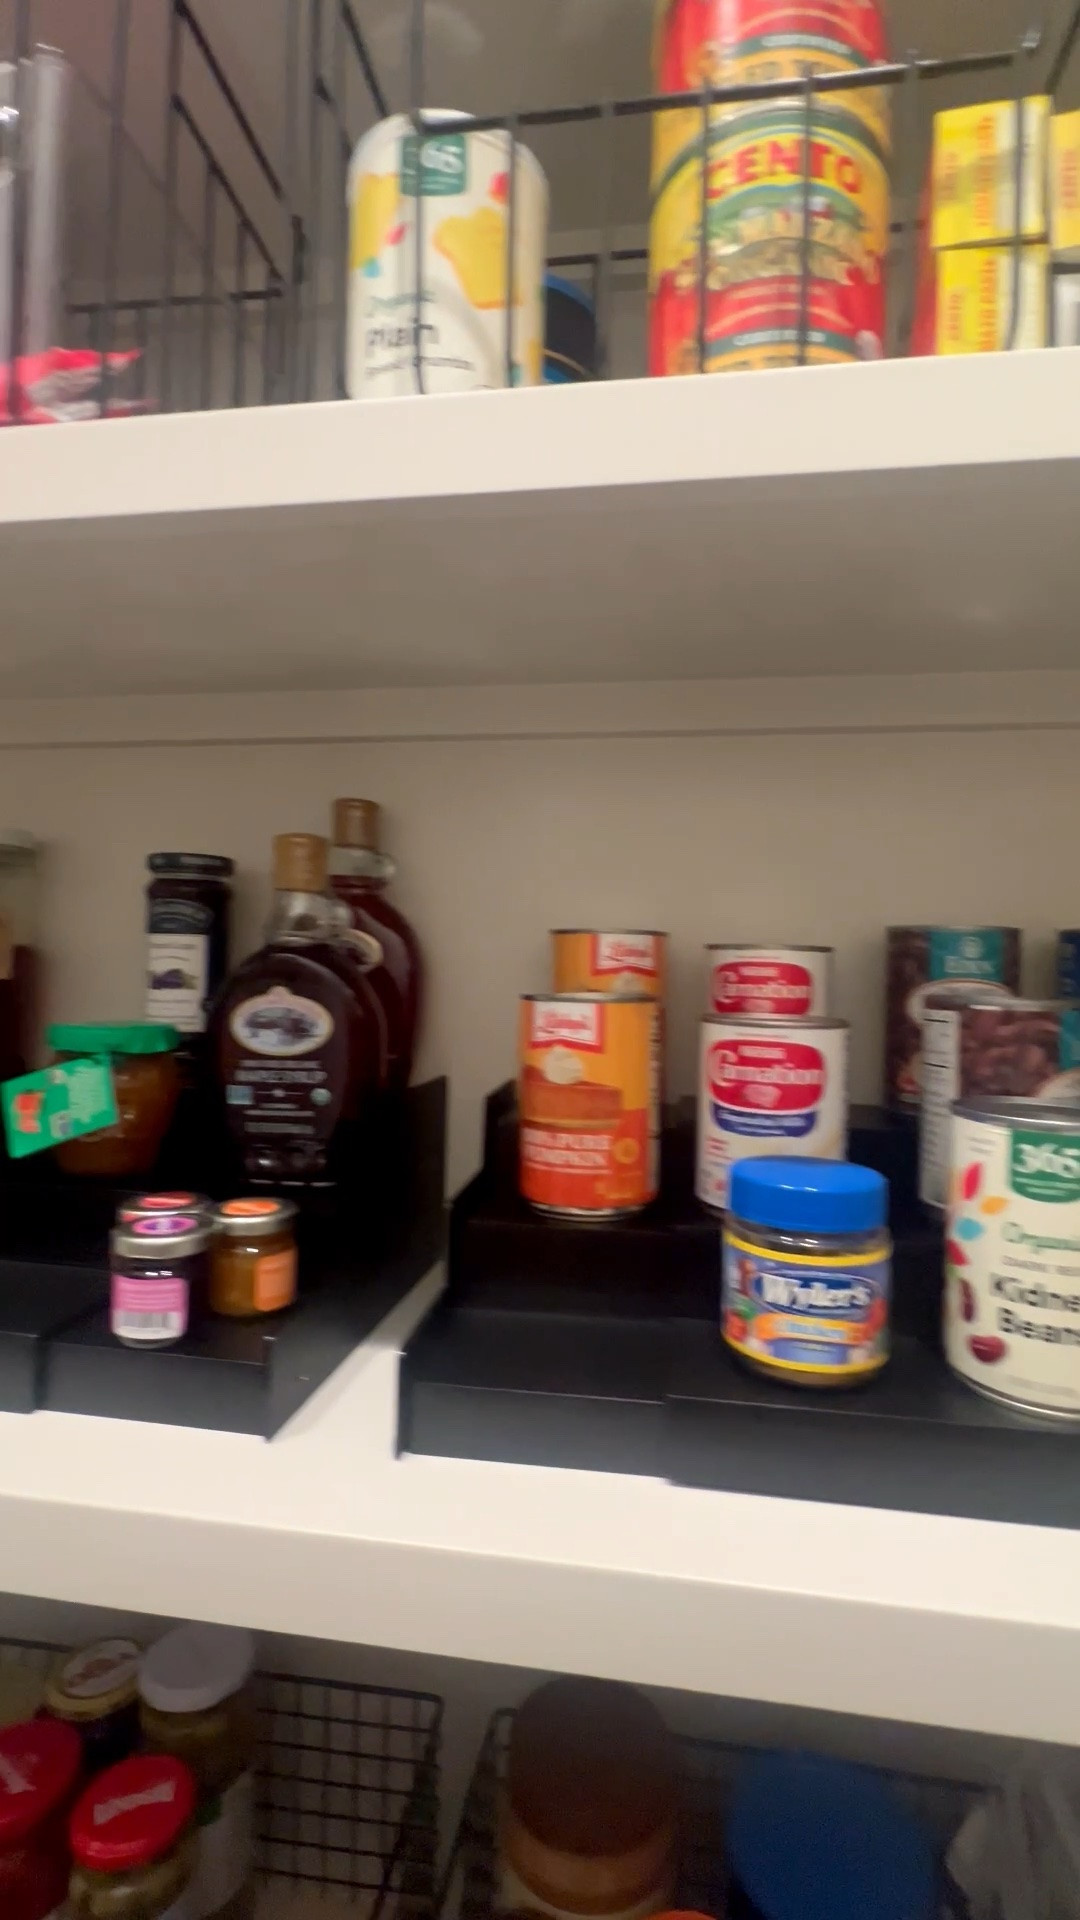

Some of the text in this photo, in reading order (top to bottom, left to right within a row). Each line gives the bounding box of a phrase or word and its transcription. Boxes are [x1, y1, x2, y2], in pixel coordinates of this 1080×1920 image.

[701, 139, 861, 199] CENTO
[1012, 1143, 1080, 1179] 365
[990, 1272, 1080, 1314] Kidne
[997, 1305, 1080, 1347] Bean
